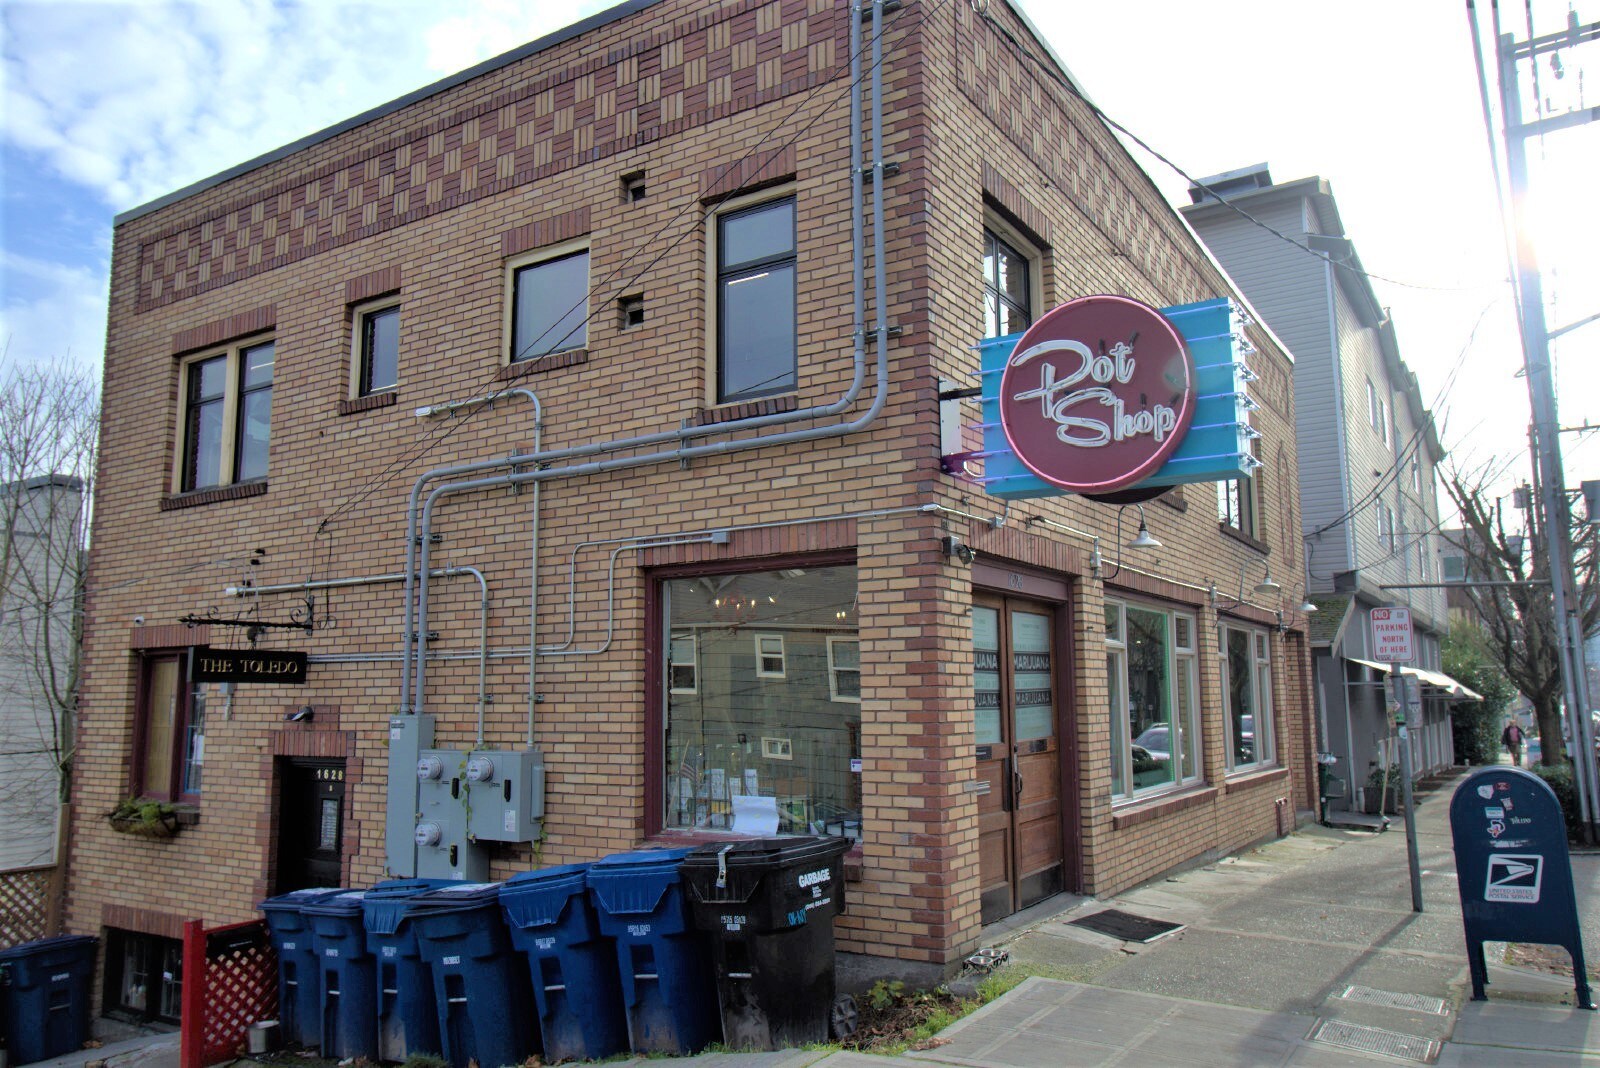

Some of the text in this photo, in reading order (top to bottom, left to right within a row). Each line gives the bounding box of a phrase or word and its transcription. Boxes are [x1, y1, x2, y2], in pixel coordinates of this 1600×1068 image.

[1010, 339, 1136, 418] Pot
[1052, 387, 1177, 448] Shop
[1373, 610, 1389, 619] NO
[201, 659, 298, 673] THE TOLEDO
[974, 653, 998, 669] JUANA
[1013, 655, 1049, 670] MARIJUANA
[1016, 691, 1050, 705] MARIJUANA
[317, 769, 342, 780] 1628
[798, 868, 831, 888] GARBAGE
